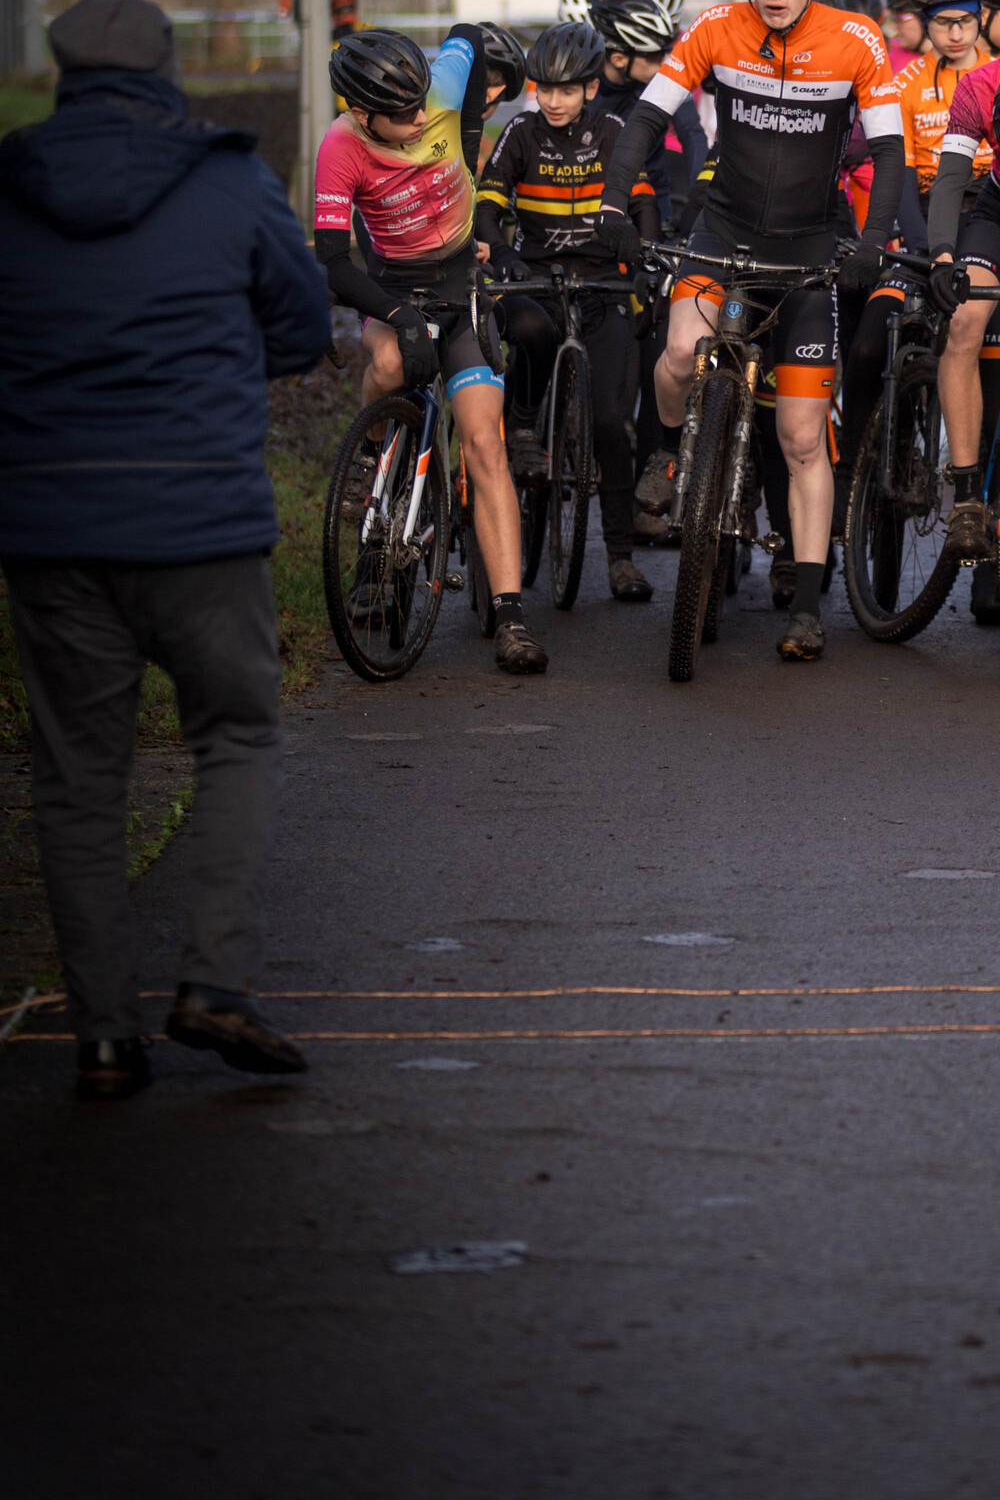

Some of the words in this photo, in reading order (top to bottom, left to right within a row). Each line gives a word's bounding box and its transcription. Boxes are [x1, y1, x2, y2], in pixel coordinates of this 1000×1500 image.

[690, 6, 732, 32] GIANT
[842, 21, 885, 70] moddit.
[738, 60, 776, 76] moddit.
[539, 164, 554, 175] DE
[796, 344, 826, 358] CC75
